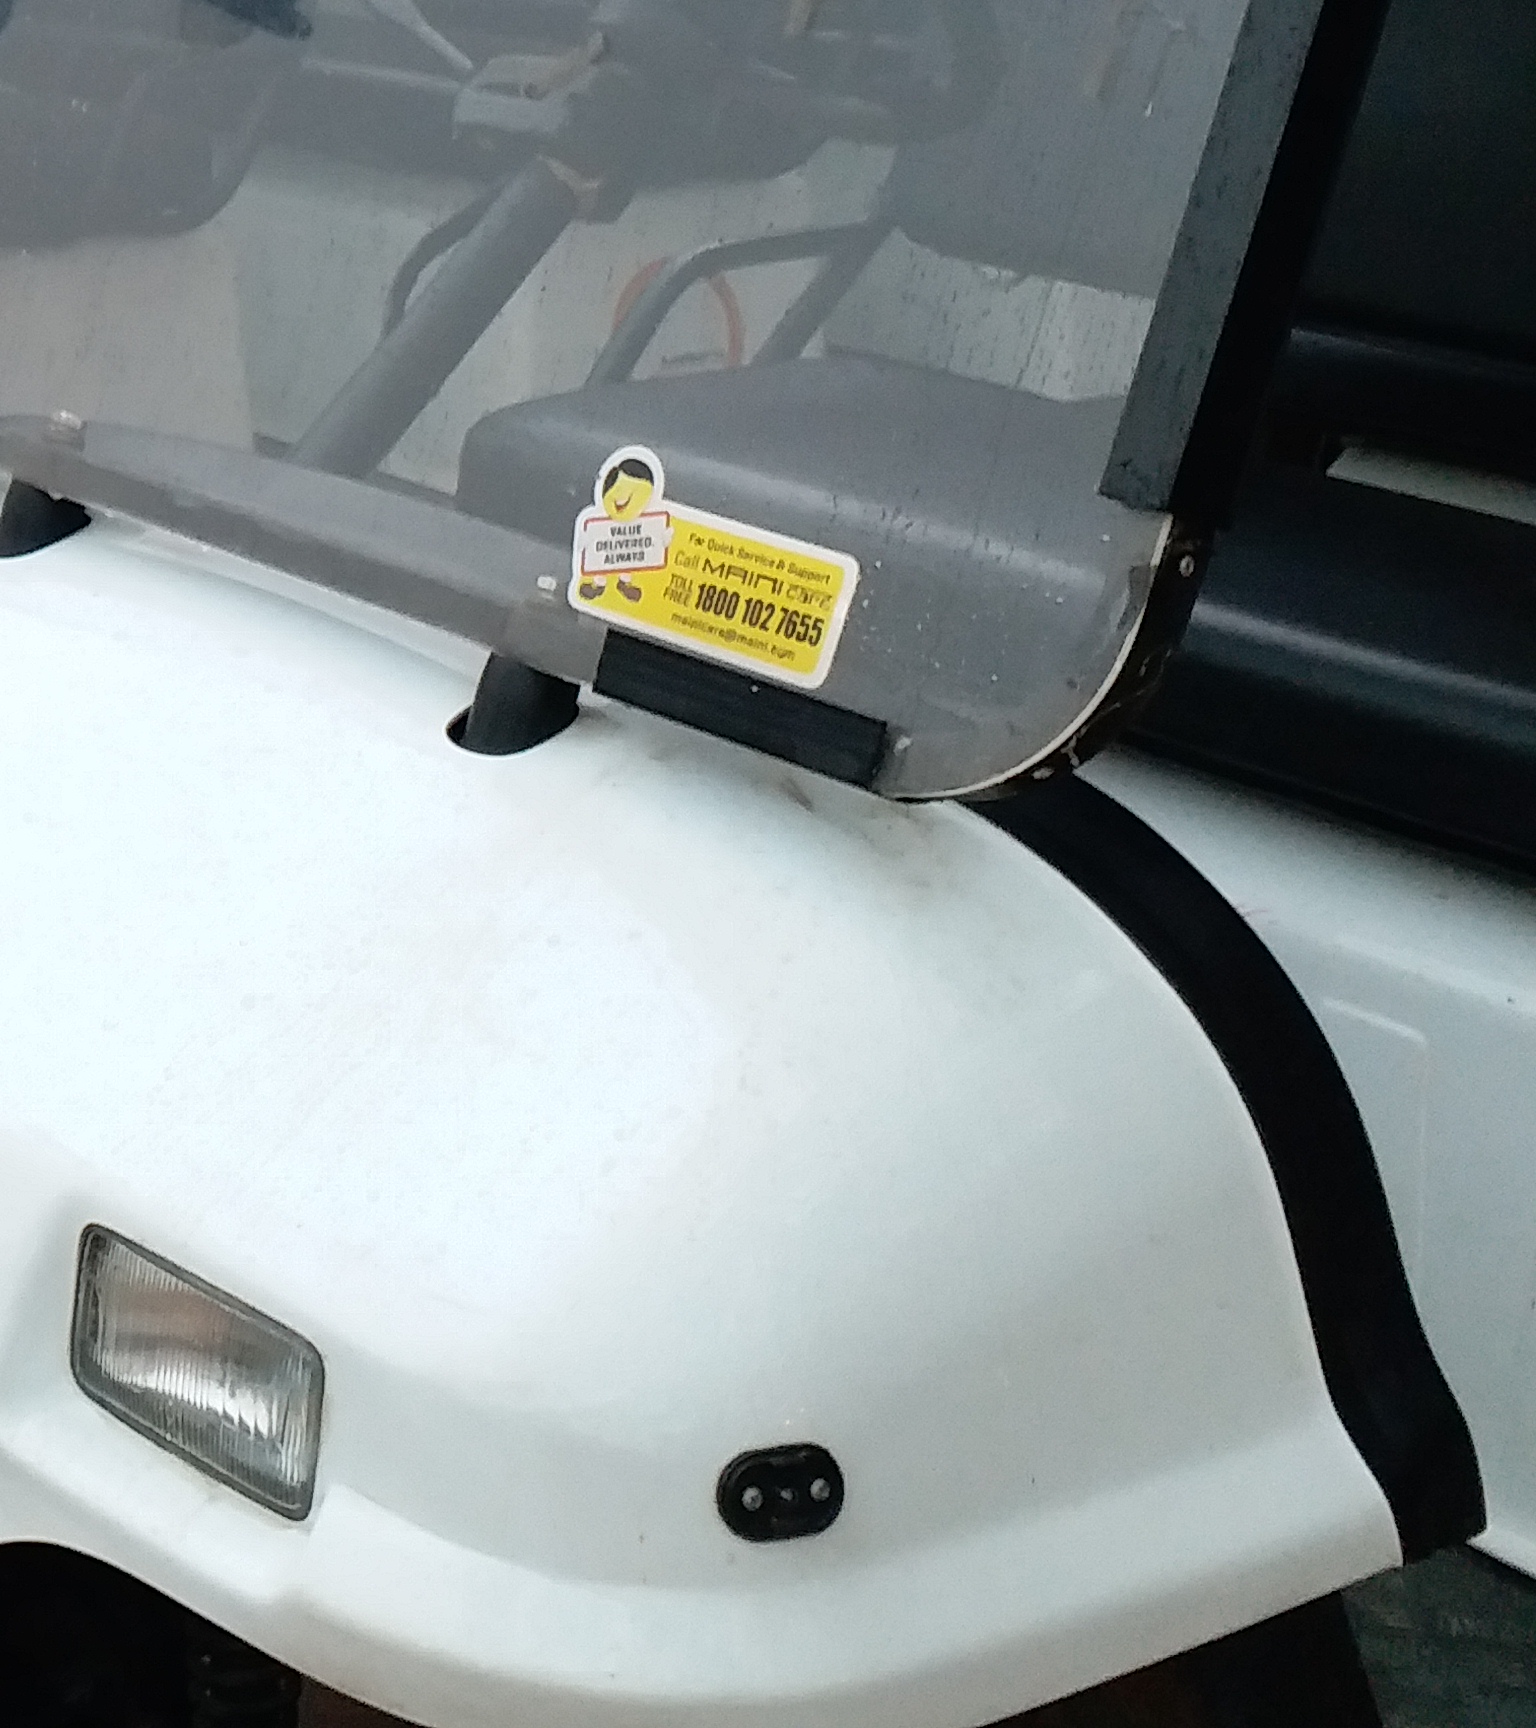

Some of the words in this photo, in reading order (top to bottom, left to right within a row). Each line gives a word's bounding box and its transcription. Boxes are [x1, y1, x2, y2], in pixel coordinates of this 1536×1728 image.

[610, 524, 642, 537] VALUE
[603, 550, 646, 565] ALWAYS
[707, 538, 735, 556] Quick
[736, 546, 775, 570] Service
[787, 561, 831, 586] Support
[670, 573, 694, 592] TOLL
[674, 549, 700, 571] Call
[702, 557, 785, 597] MAINI
[664, 585, 693, 608] FREE
[694, 583, 741, 621] 1800
[741, 597, 777, 633] 102
[775, 605, 826, 648] 7655
